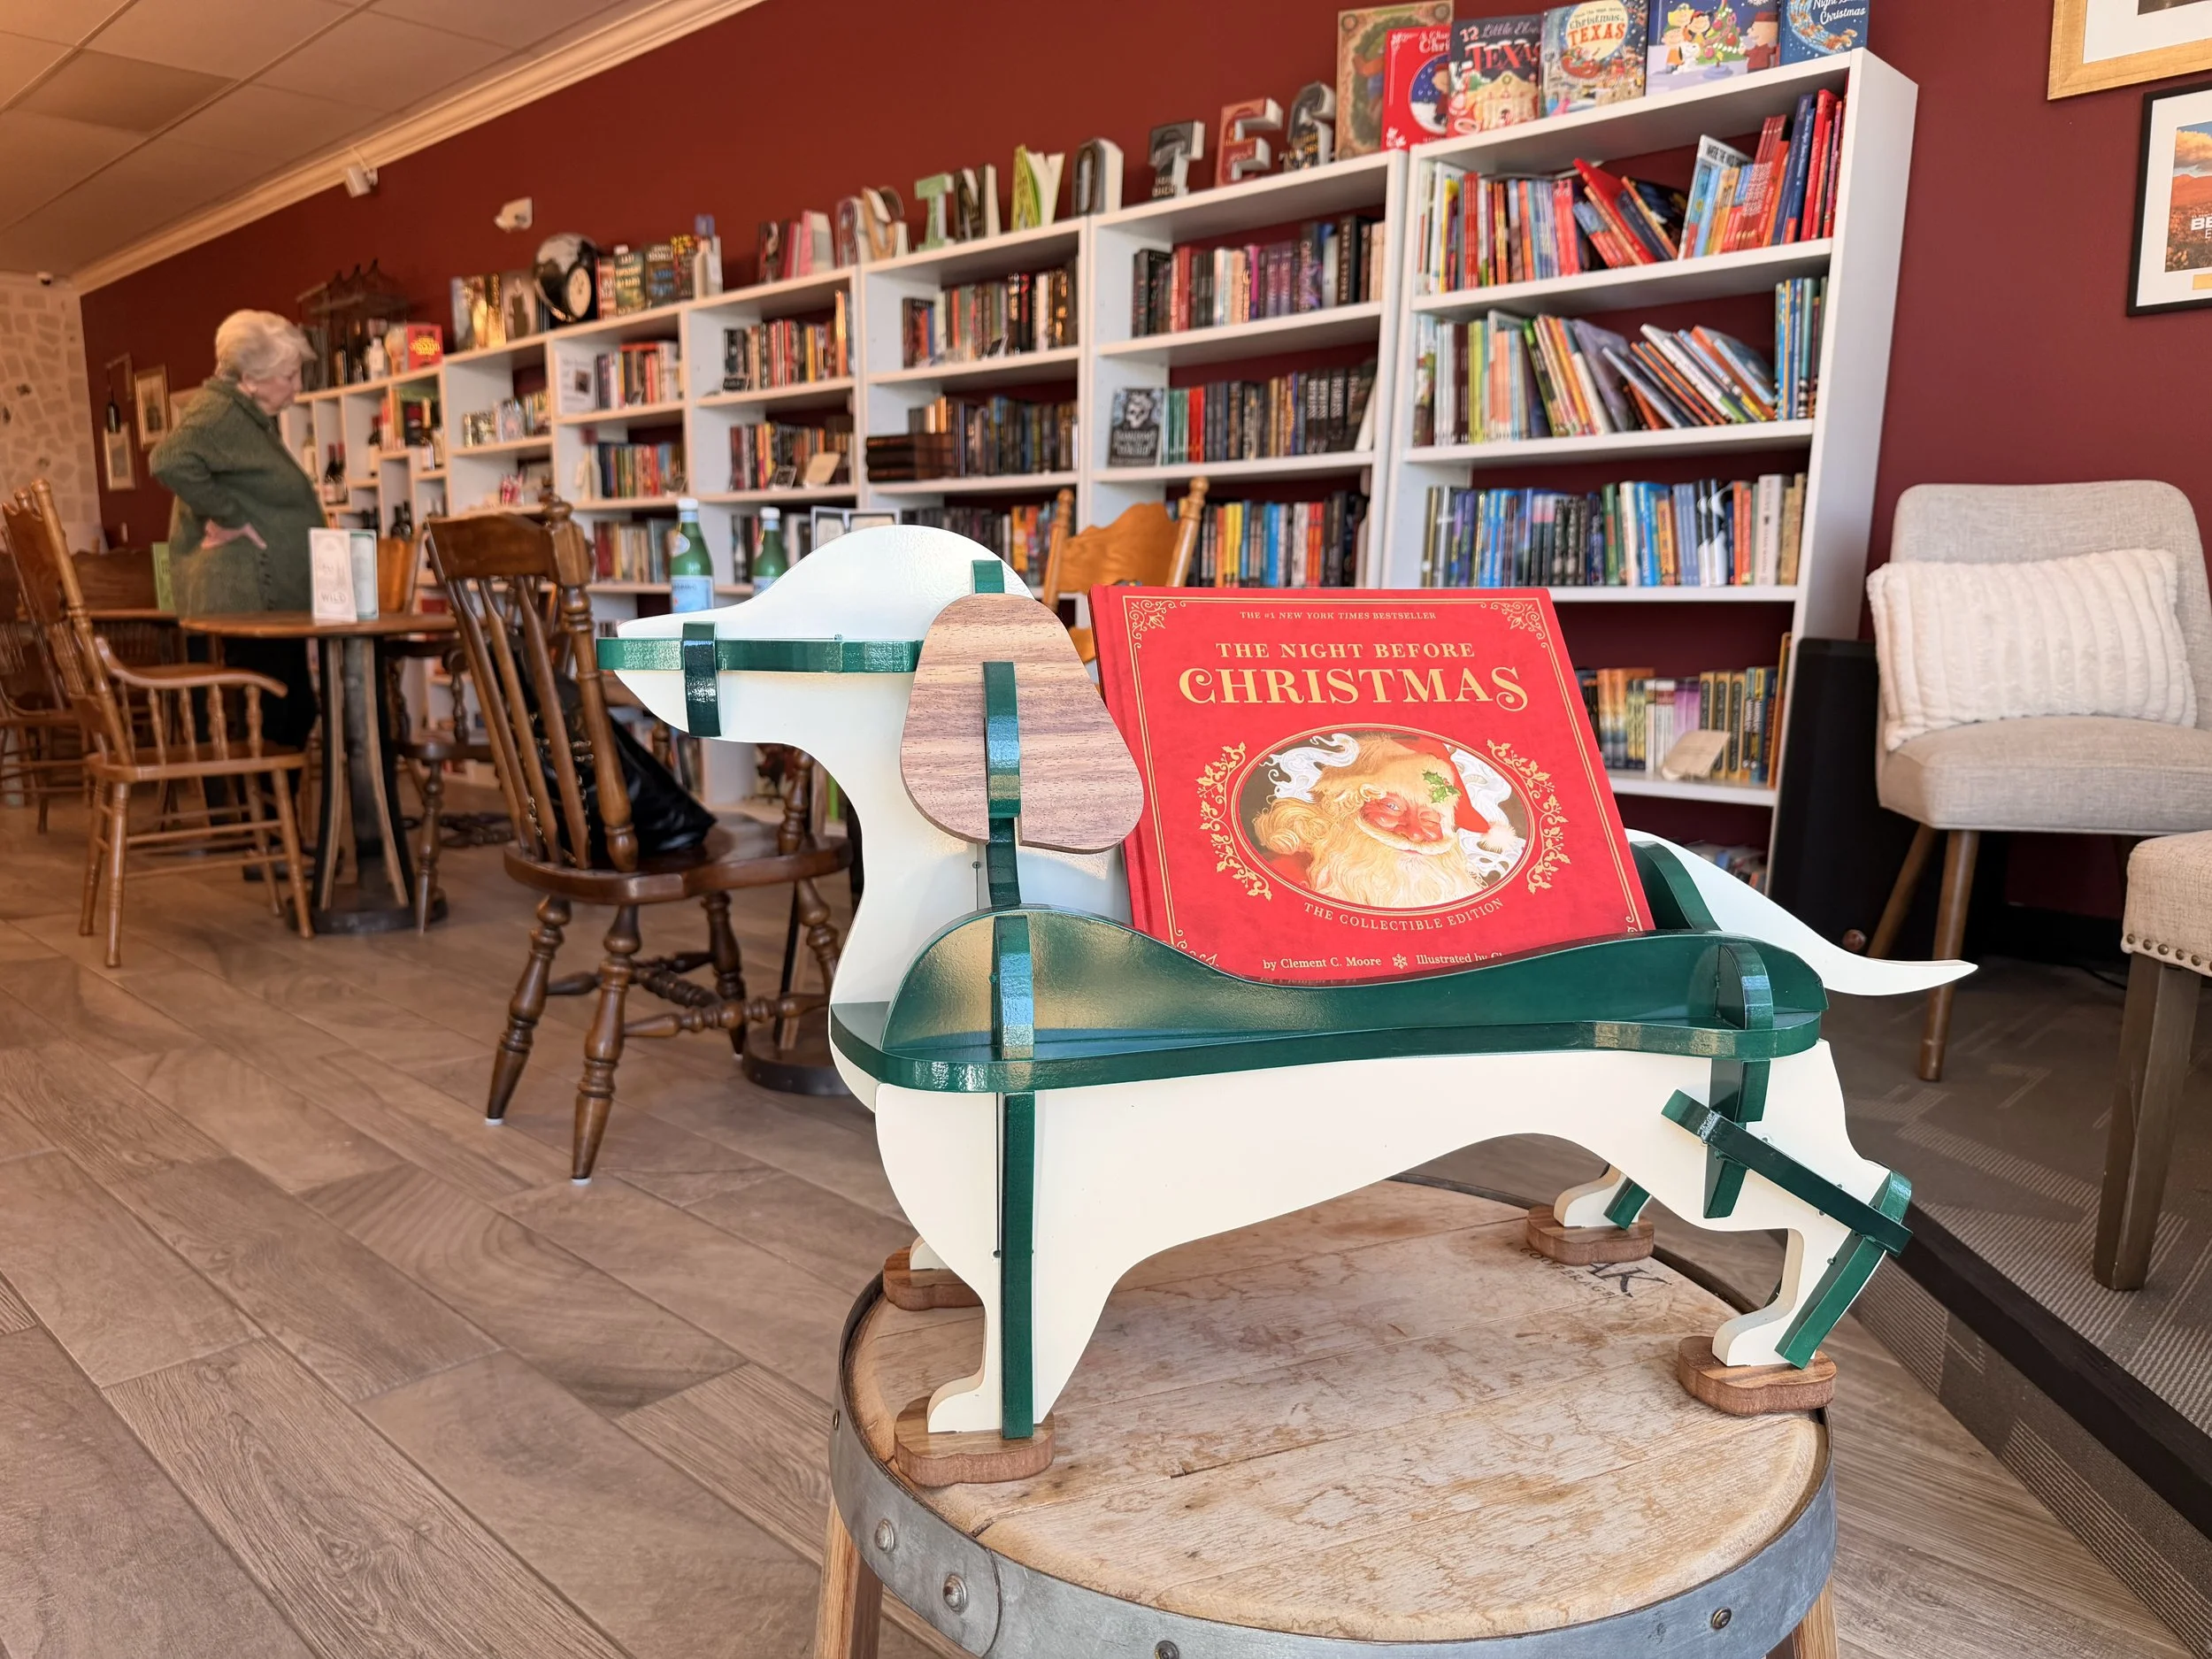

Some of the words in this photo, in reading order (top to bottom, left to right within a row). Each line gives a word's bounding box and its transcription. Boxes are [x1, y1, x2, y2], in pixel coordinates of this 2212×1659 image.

[1570, 14, 1620, 29] Christmas
[1820, 8, 1866, 25] Christmas
[1459, 26, 1479, 42] 12
[1568, 23, 1625, 47] TEXAS
[1215, 642, 1269, 658] THE
[1279, 642, 1363, 658] NIGHT
[1372, 642, 1475, 658] BEFORE
[1179, 666, 1528, 712] CHRISTMAS
[1303, 902, 1333, 920] THE
[1339, 914, 1442, 931] COLLECTIBLE
[1446, 897, 1504, 926] EDITION
[1263, 960, 1277, 972] by
[1280, 957, 1327, 969] Clement
[1331, 956, 1342, 967] C.
[1346, 956, 1382, 967] Moore
[1416, 953, 1472, 964] Illustrated
